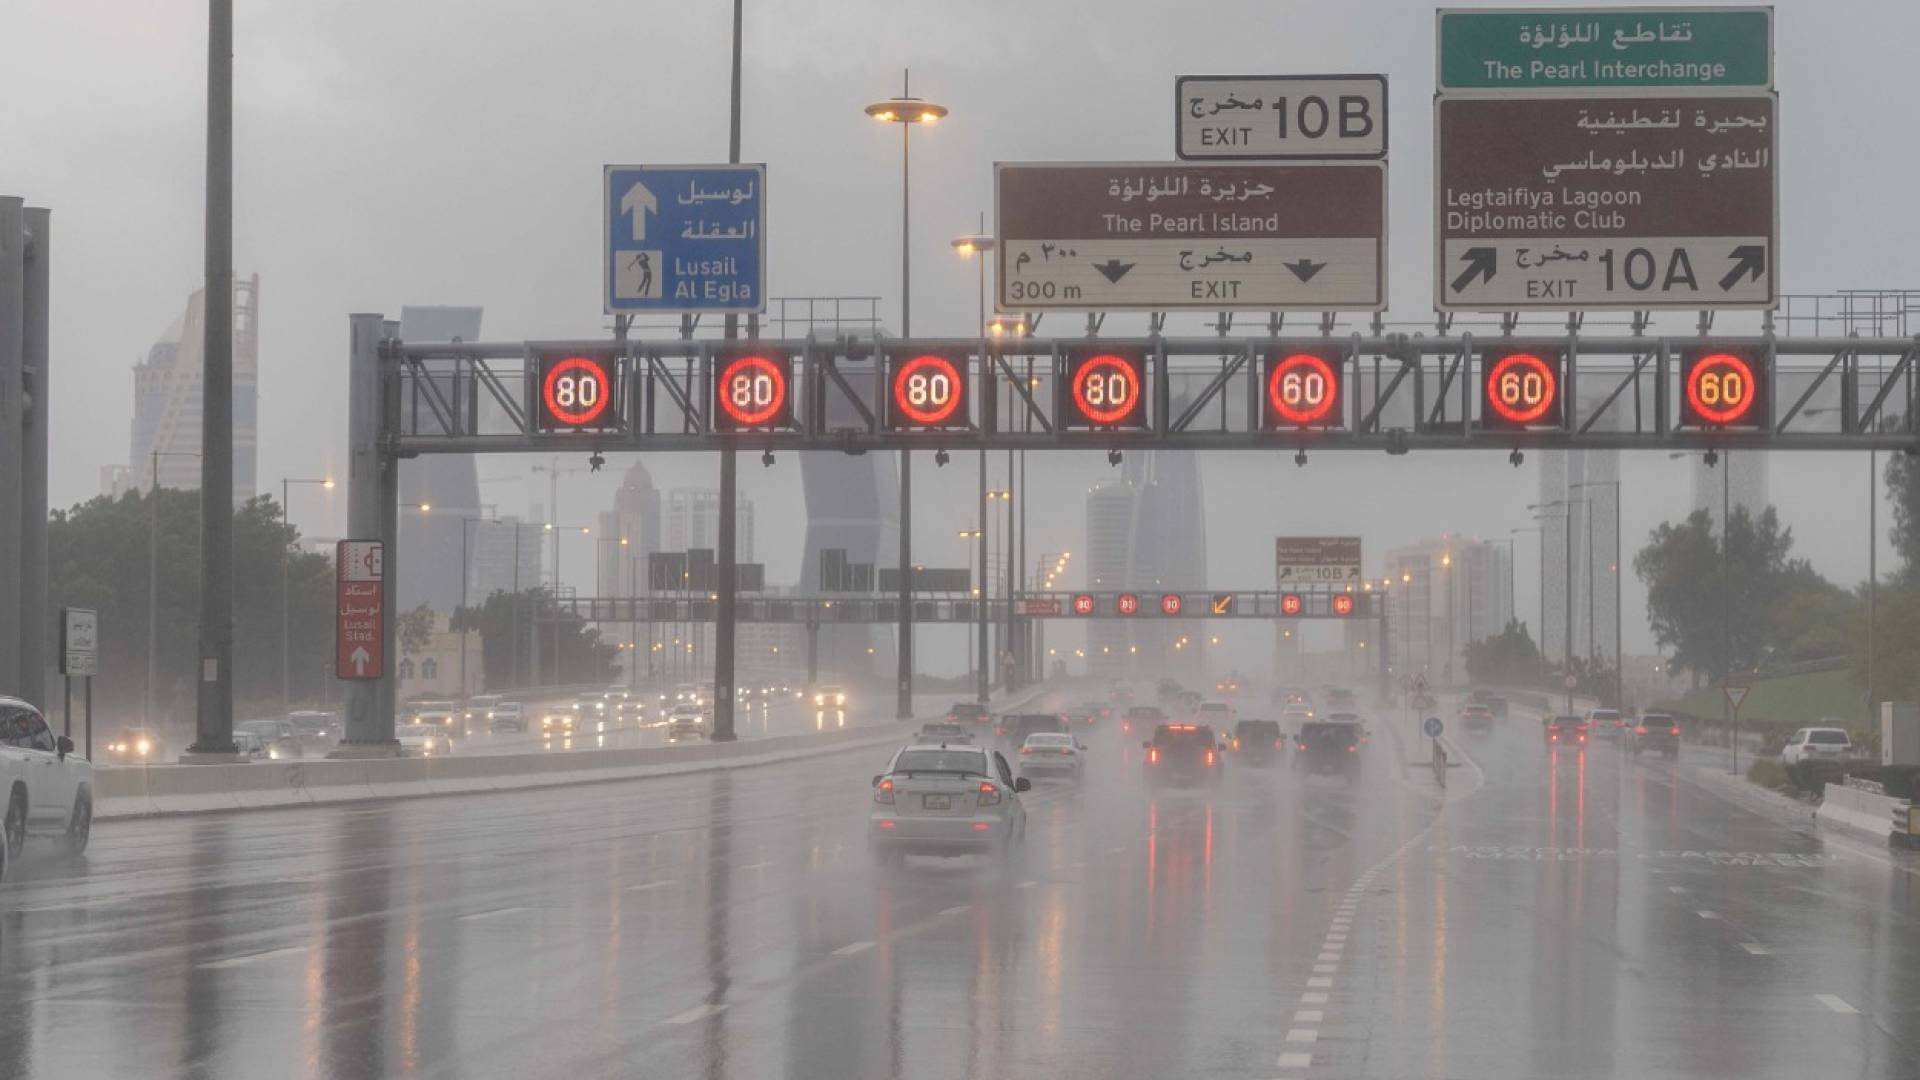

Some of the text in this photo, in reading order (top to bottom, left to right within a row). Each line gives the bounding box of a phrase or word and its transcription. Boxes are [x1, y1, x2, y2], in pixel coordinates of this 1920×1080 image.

[1520, 23, 1692, 49] تقاطع اللؤلؤة
[1484, 60, 1726, 81] The Pearl Interchange
[1190, 92, 1263, 118] مخرج
[1272, 95, 1374, 139] 10B
[1577, 110, 1767, 135] بحيرة لقطيفية
[1201, 128, 1253, 146] EXIT
[1543, 148, 1768, 183] النادي الدبلوماسي
[678, 180, 753, 205] لوسيل
[1109, 176, 1275, 201] جزيرة اللؤلؤة
[1447, 188, 1641, 210] Legtaifiya Lagoon
[681, 220, 755, 239] العقلة
[1103, 213, 1278, 232] The Pearl Island
[1447, 211, 1626, 233] Diplomatic Club
[675, 256, 737, 275] Lusail
[1016, 243, 1077, 273] ٣٠٠ م
[1179, 245, 1253, 270] مخرج
[1515, 244, 1589, 269] مخرج
[1599, 247, 1699, 292] 10A
[675, 281, 751, 302] Al Egla
[1011, 281, 1081, 299] 300 m
[1191, 280, 1242, 299] EXIT
[1527, 280, 1577, 298] EXIT
[556, 377, 597, 406] 80
[732, 375, 772, 406] 80
[908, 374, 949, 405] 80
[1086, 374, 1126, 405] 80
[1283, 373, 1324, 405] 60
[1501, 373, 1542, 405] 60
[1701, 372, 1742, 405] 60
